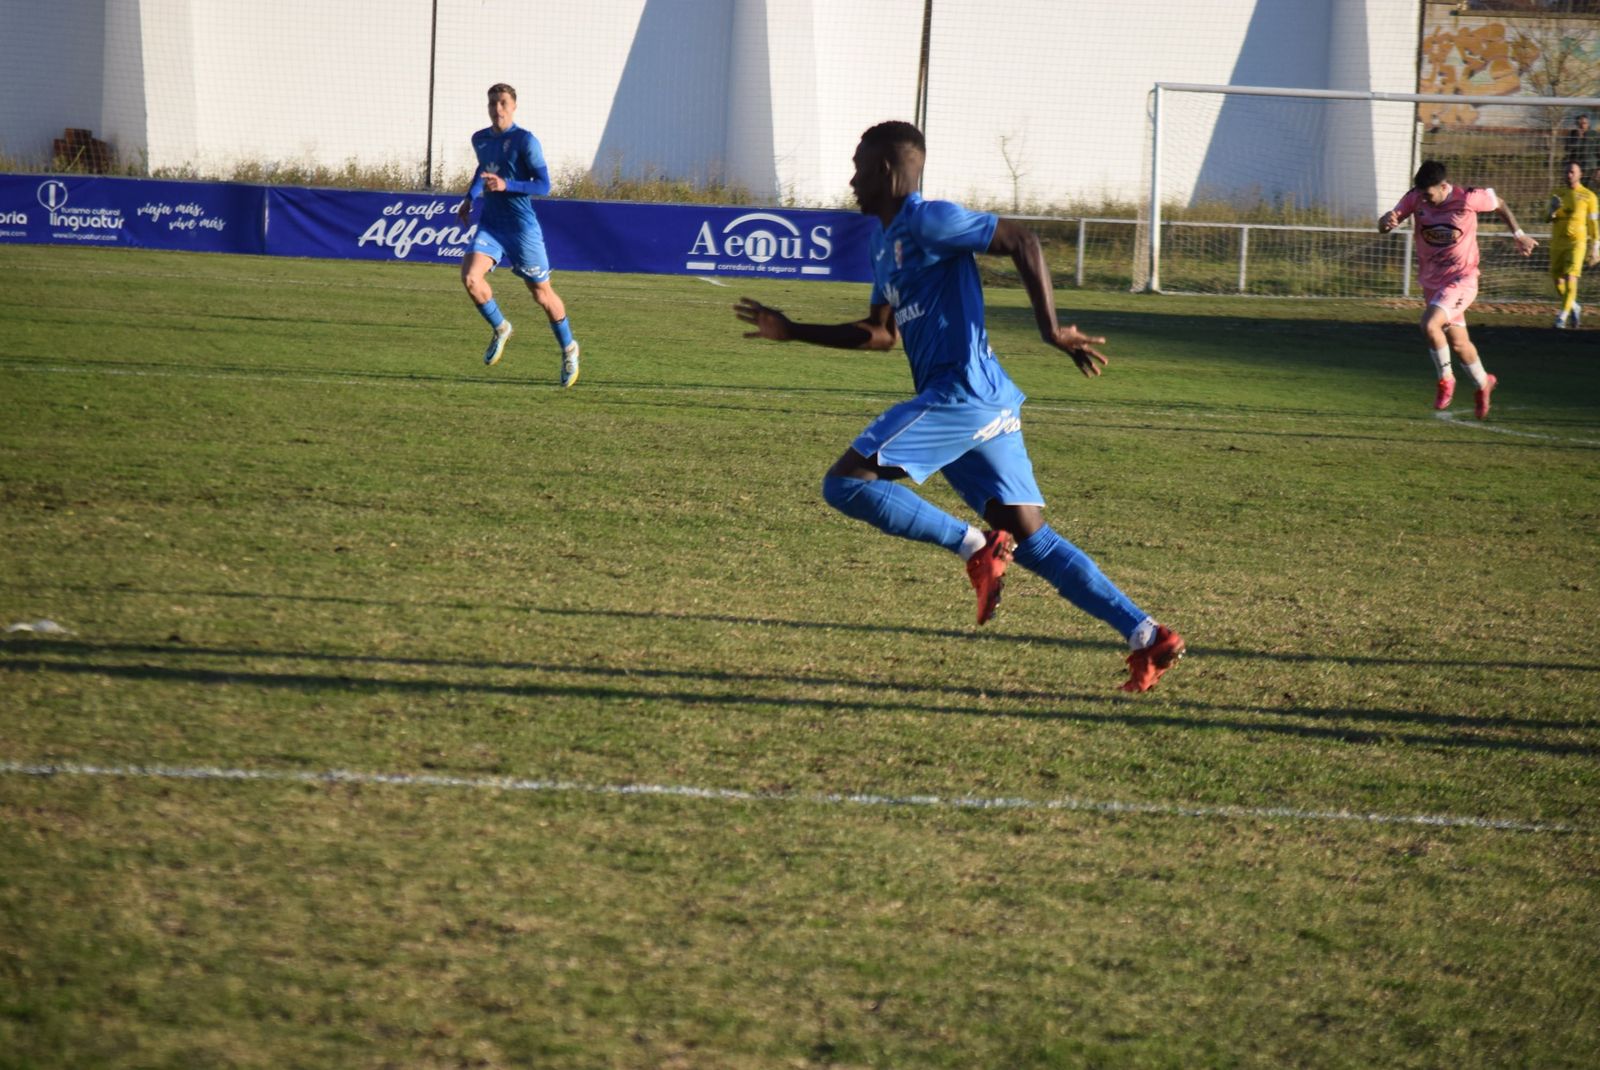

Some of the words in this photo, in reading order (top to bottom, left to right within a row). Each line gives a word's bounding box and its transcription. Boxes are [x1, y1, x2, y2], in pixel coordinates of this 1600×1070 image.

[61, 206, 91, 215] turismo
[92, 207, 121, 217] cultural
[137, 202, 173, 222] viaja
[174, 201, 205, 218] más,
[383, 201, 403, 216] el
[405, 200, 446, 221] café
[449, 199, 474, 214] d
[49, 213, 125, 231] linguatur
[168, 216, 198, 231] vive
[199, 216, 226, 231] más
[52, 232, 118, 241] www.linguatur.com
[357, 217, 479, 259] Alfons
[756, 264, 767, 273] de
[767, 265, 797, 275] seguros
[894, 303, 926, 326] URAL
